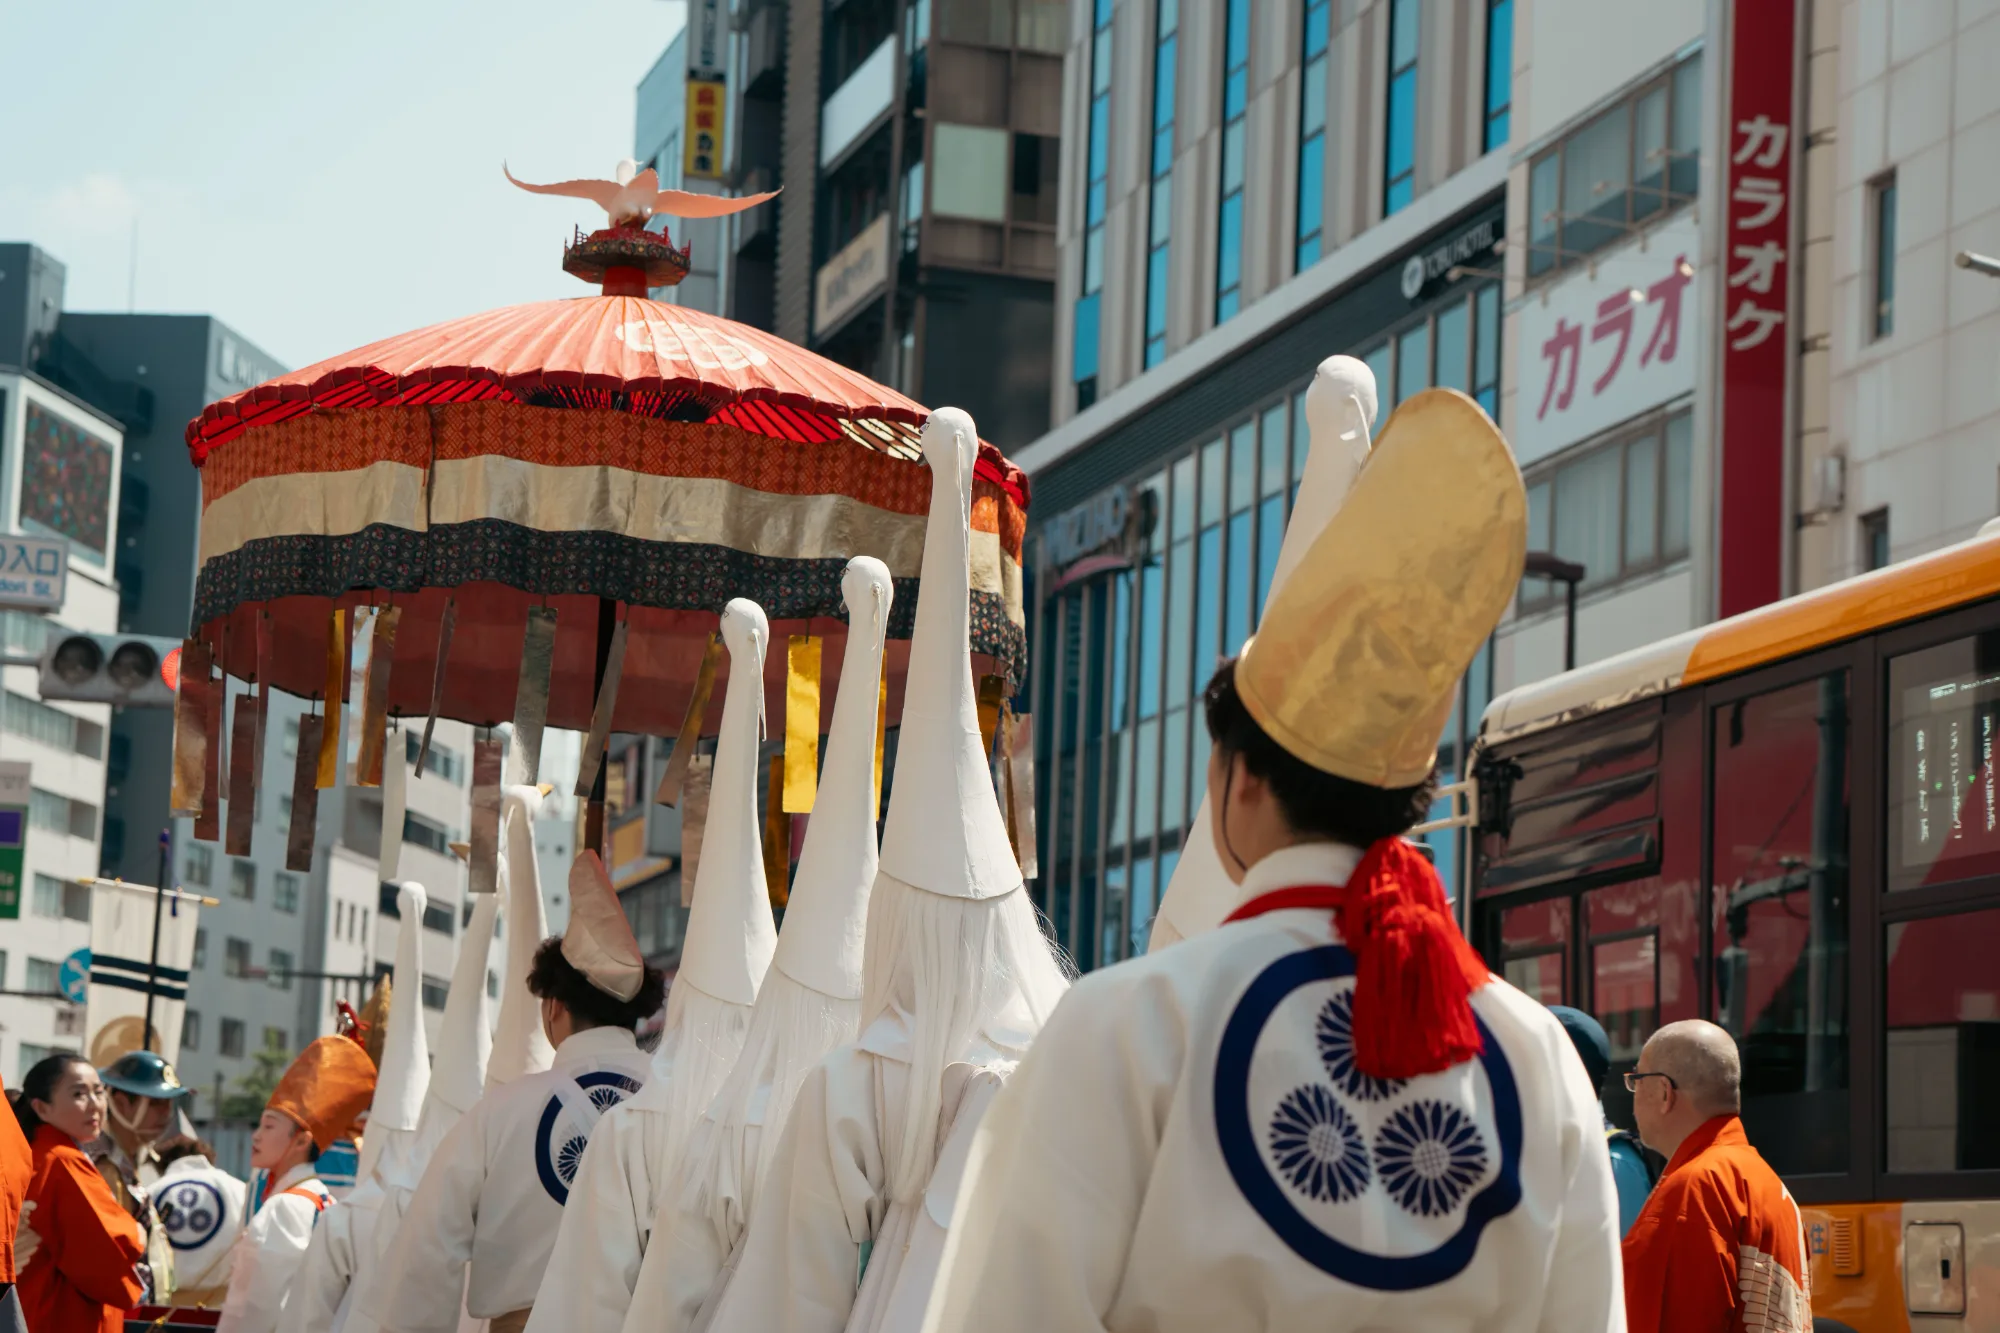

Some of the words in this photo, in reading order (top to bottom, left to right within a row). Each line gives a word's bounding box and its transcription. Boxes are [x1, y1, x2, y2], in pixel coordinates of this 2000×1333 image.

[1453, 221, 1493, 261] HOTEL
[1727, 114, 1788, 351] カラオケ
[1536, 252, 1693, 422] カラオ
[1043, 484, 1127, 566] MIZUHO
